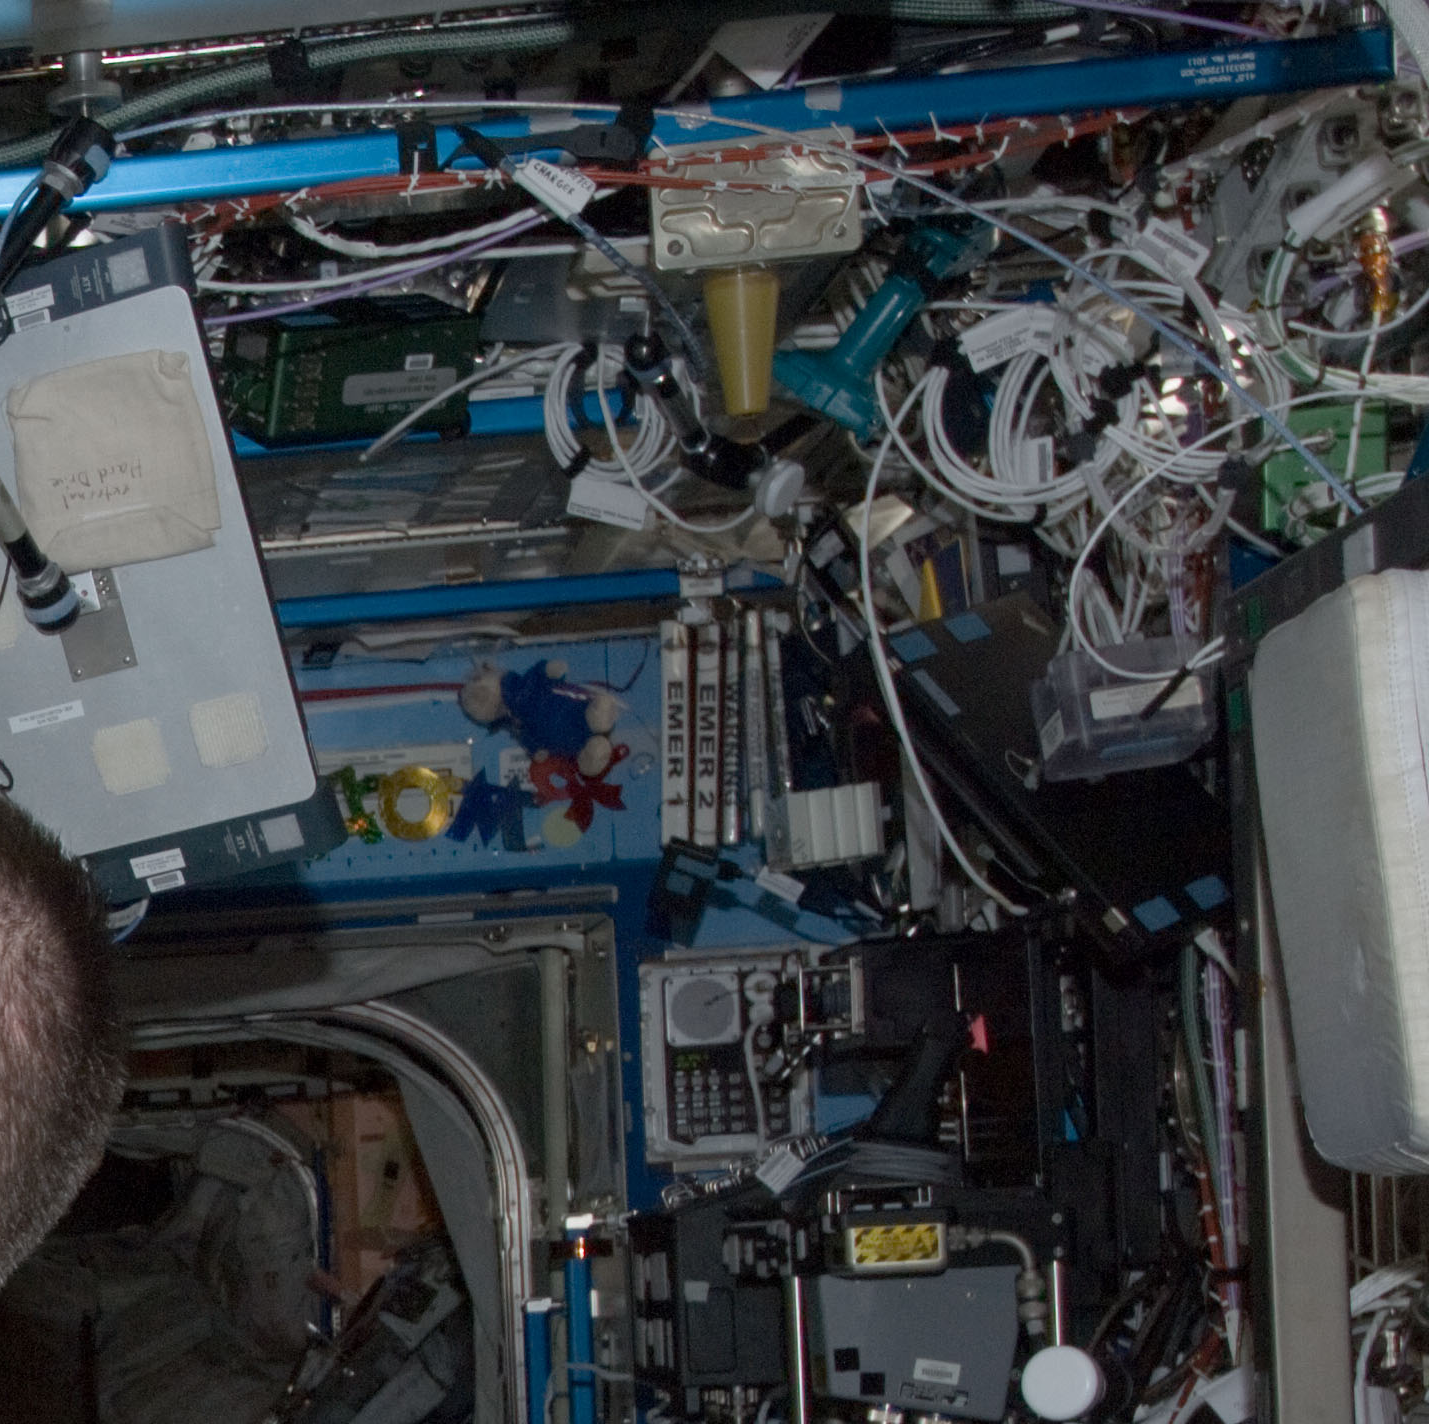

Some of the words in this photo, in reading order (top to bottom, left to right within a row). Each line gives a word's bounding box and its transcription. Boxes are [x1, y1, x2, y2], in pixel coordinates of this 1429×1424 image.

[98, 459, 142, 484] Hard
[667, 681, 684, 779] EMER
[699, 684, 716, 778] EMER
[668, 794, 685, 807] 1
[699, 792, 715, 809] 2
